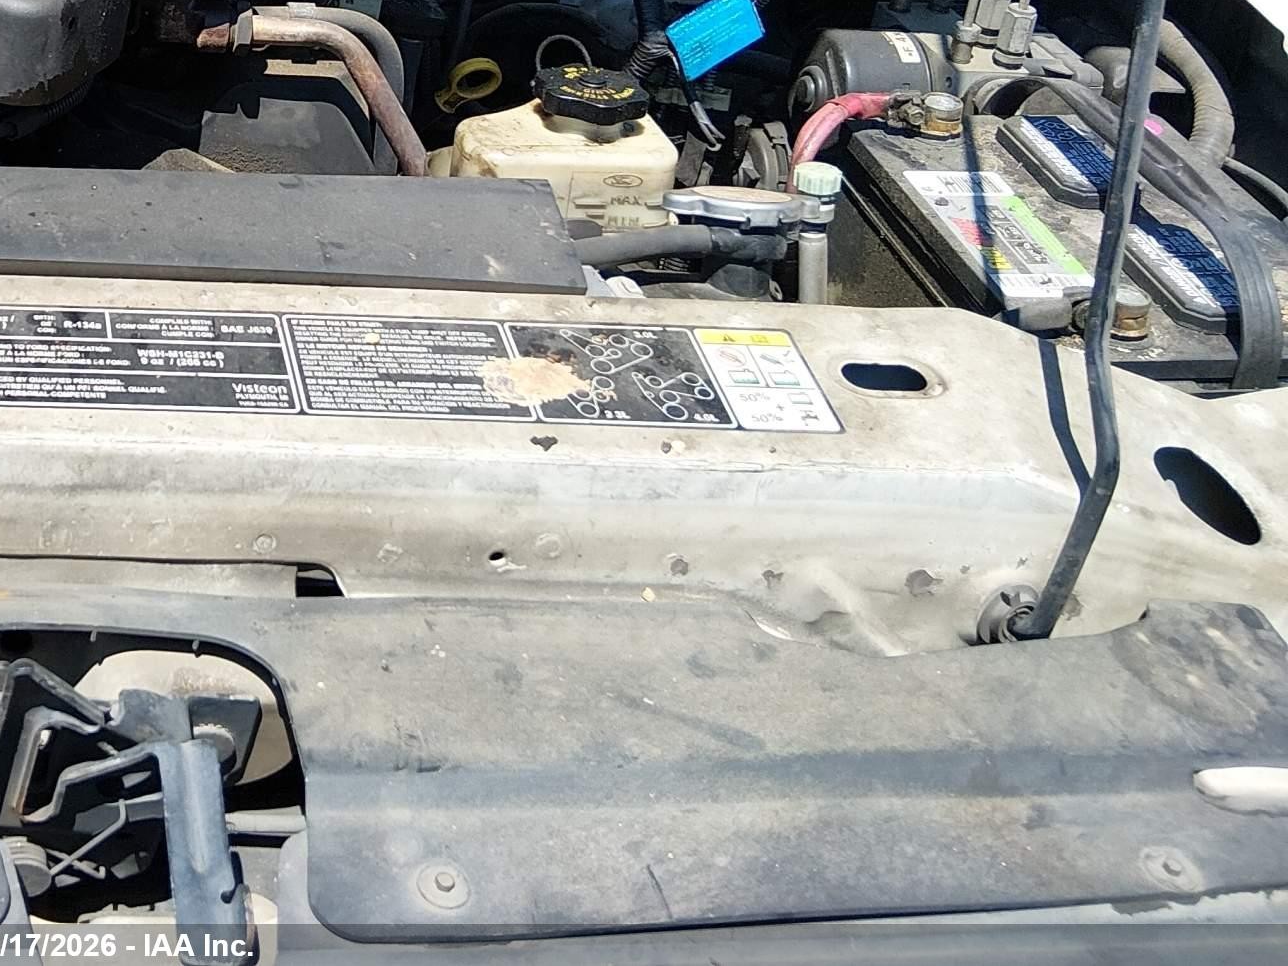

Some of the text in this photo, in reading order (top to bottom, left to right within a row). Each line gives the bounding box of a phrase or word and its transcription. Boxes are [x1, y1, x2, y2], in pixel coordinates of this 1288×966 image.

[610, 195, 643, 206] MAX
[608, 216, 640, 227] MIN
[63, 320, 102, 330] R-134a
[220, 324, 244, 334] SAE
[633, 330, 658, 340] 3.0L
[232, 382, 288, 394] Visteon
[740, 392, 770, 403] 50%
[693, 412, 720, 423] 4.0L
[751, 412, 784, 423] 50%
